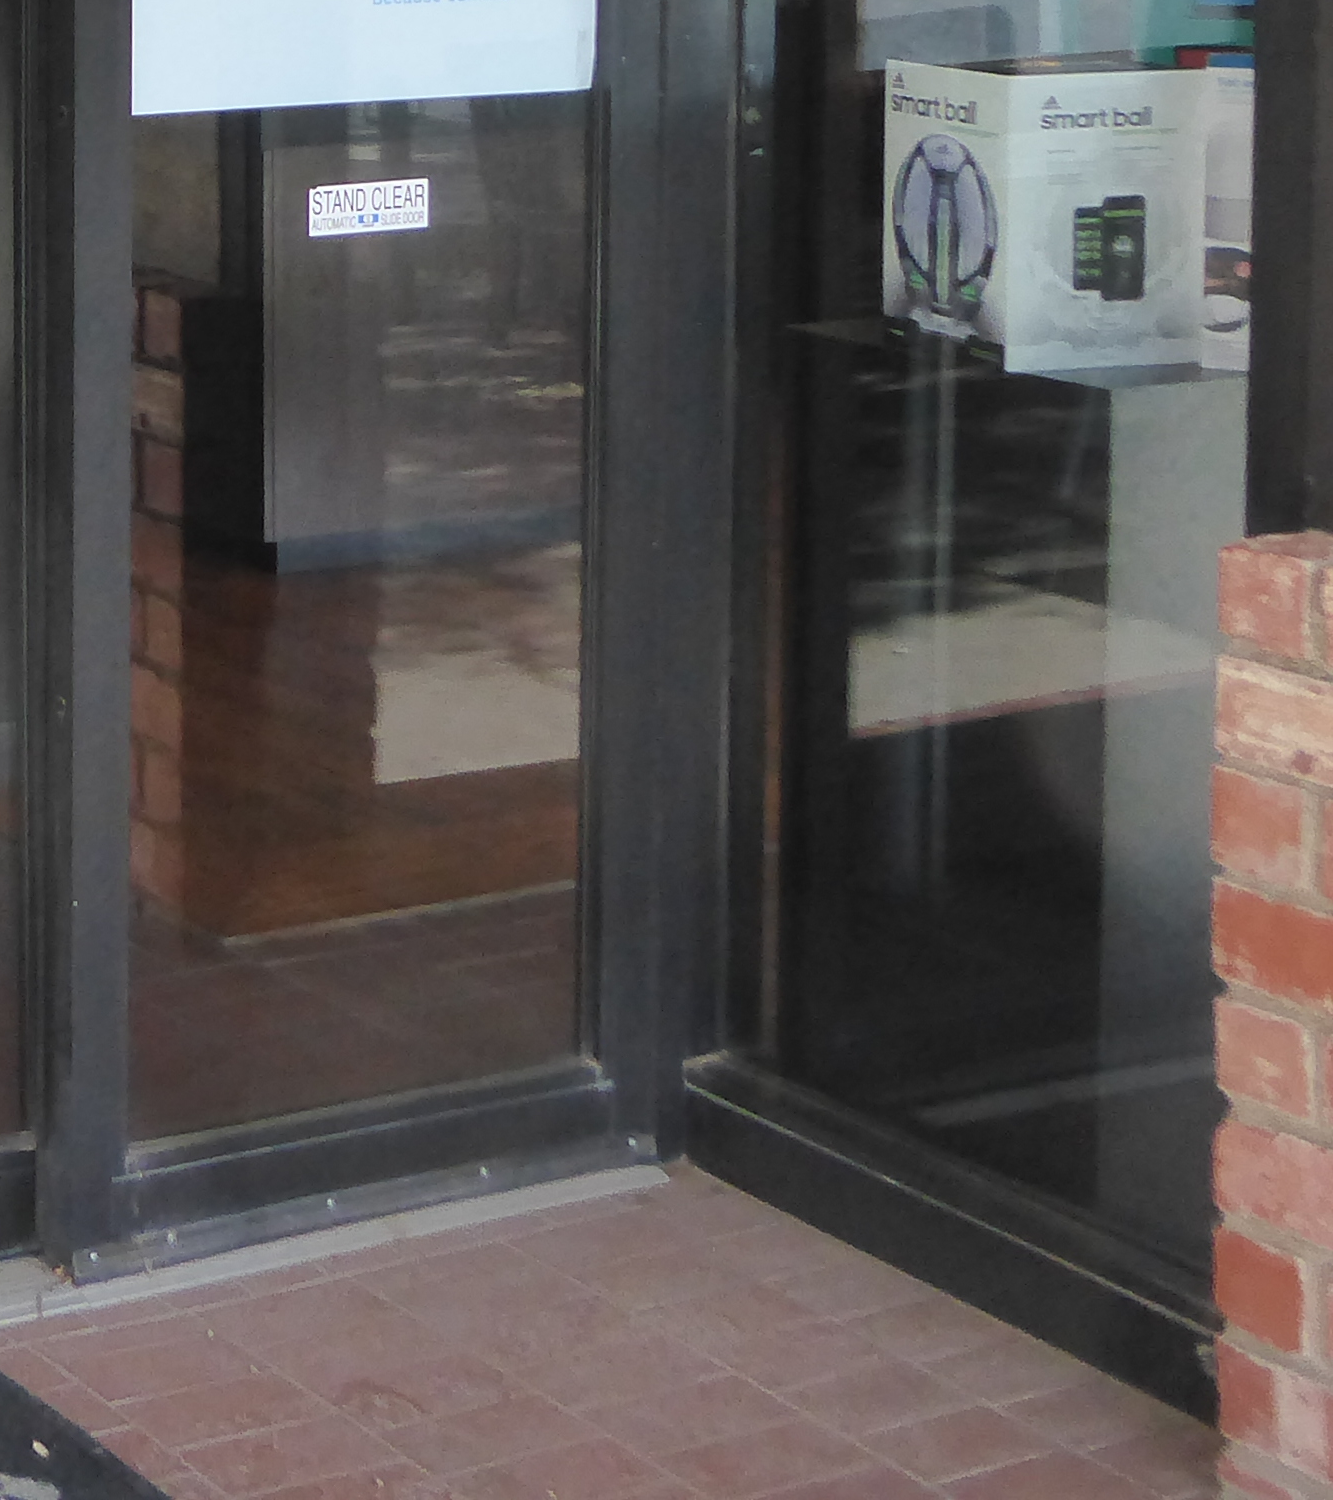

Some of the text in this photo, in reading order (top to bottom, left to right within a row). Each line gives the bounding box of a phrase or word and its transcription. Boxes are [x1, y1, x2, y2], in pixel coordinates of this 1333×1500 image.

[892, 93, 942, 119] smart
[1041, 106, 1153, 129] smart ball
[313, 184, 425, 215] STAND CLEAR
